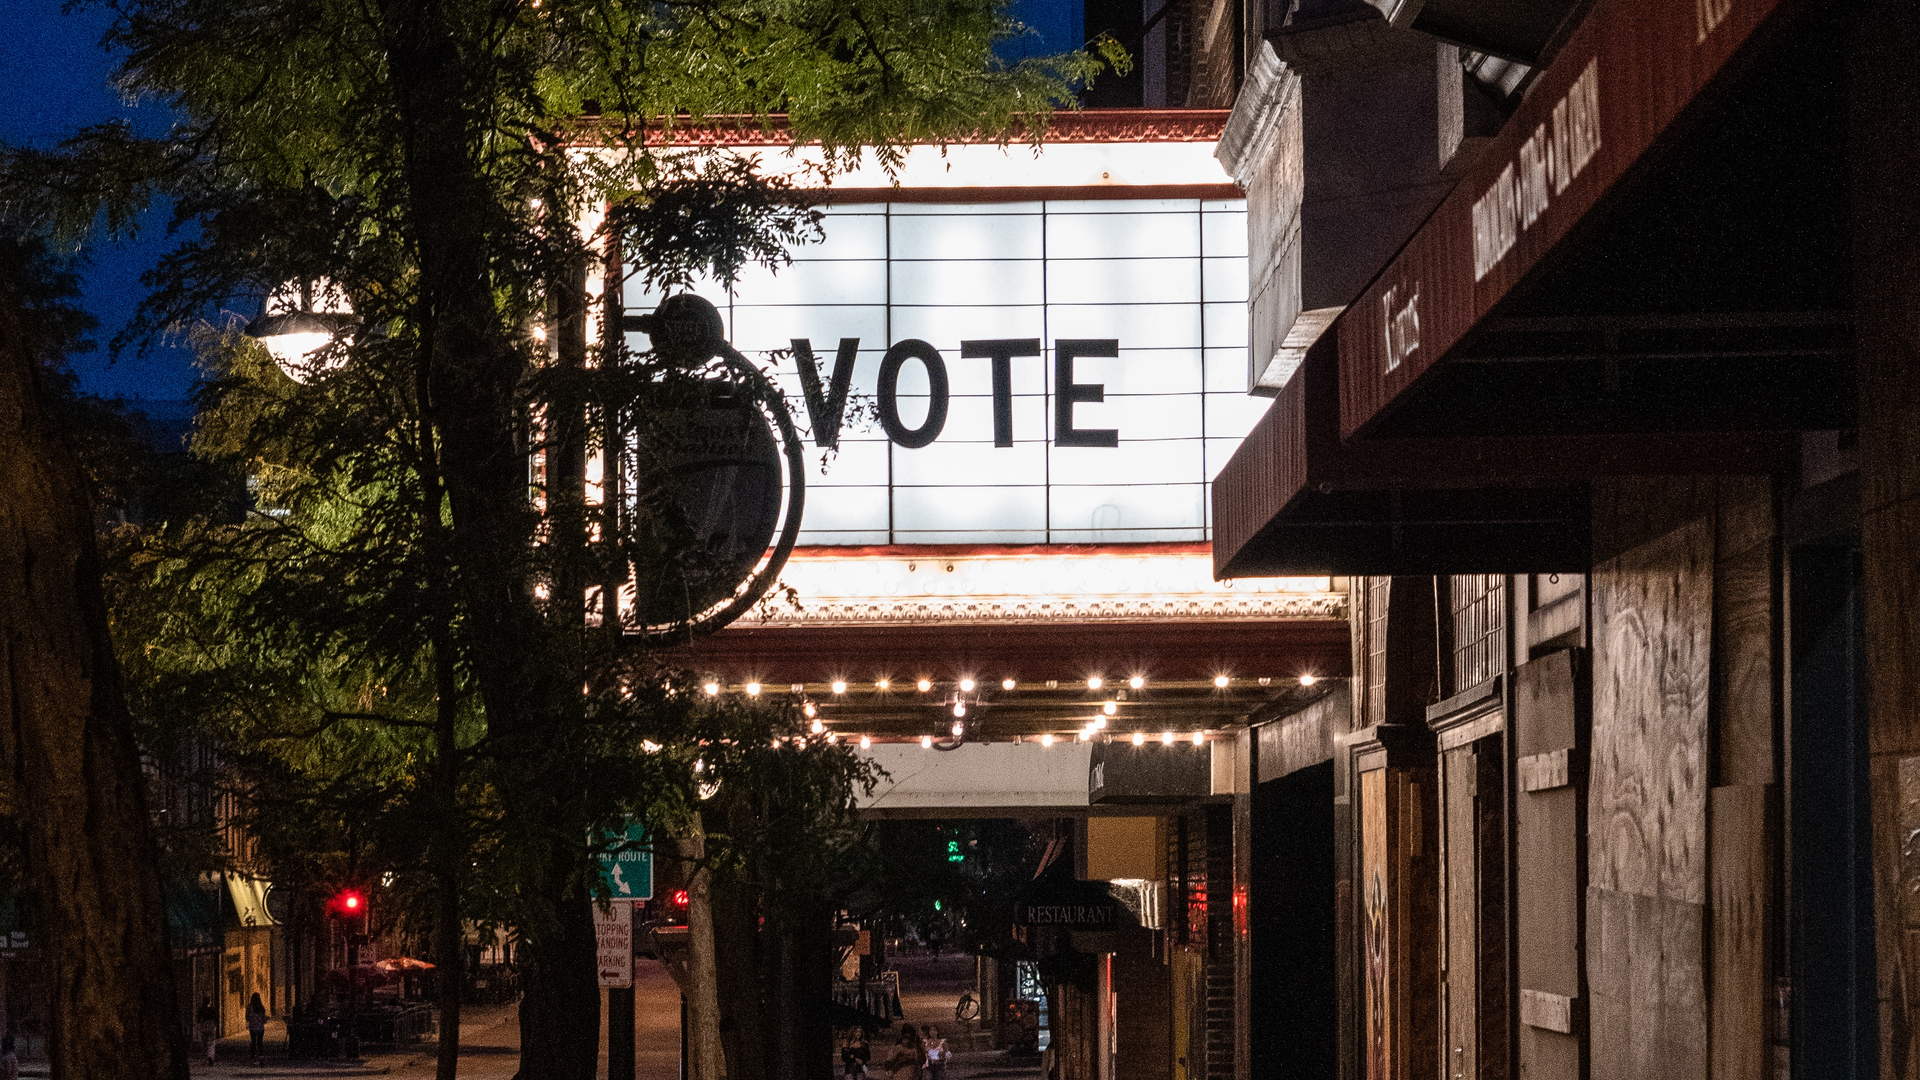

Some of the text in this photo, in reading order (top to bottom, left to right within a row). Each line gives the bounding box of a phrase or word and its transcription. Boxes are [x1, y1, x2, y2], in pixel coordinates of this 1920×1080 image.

[790, 338, 1118, 448] VOTE
[618, 850, 648, 862] ROUTE
[1028, 906, 1114, 923] RESTAURANT
[597, 924, 629, 936] TOPPING
[596, 938, 629, 949] TANDING
[597, 955, 626, 968] ARKING
